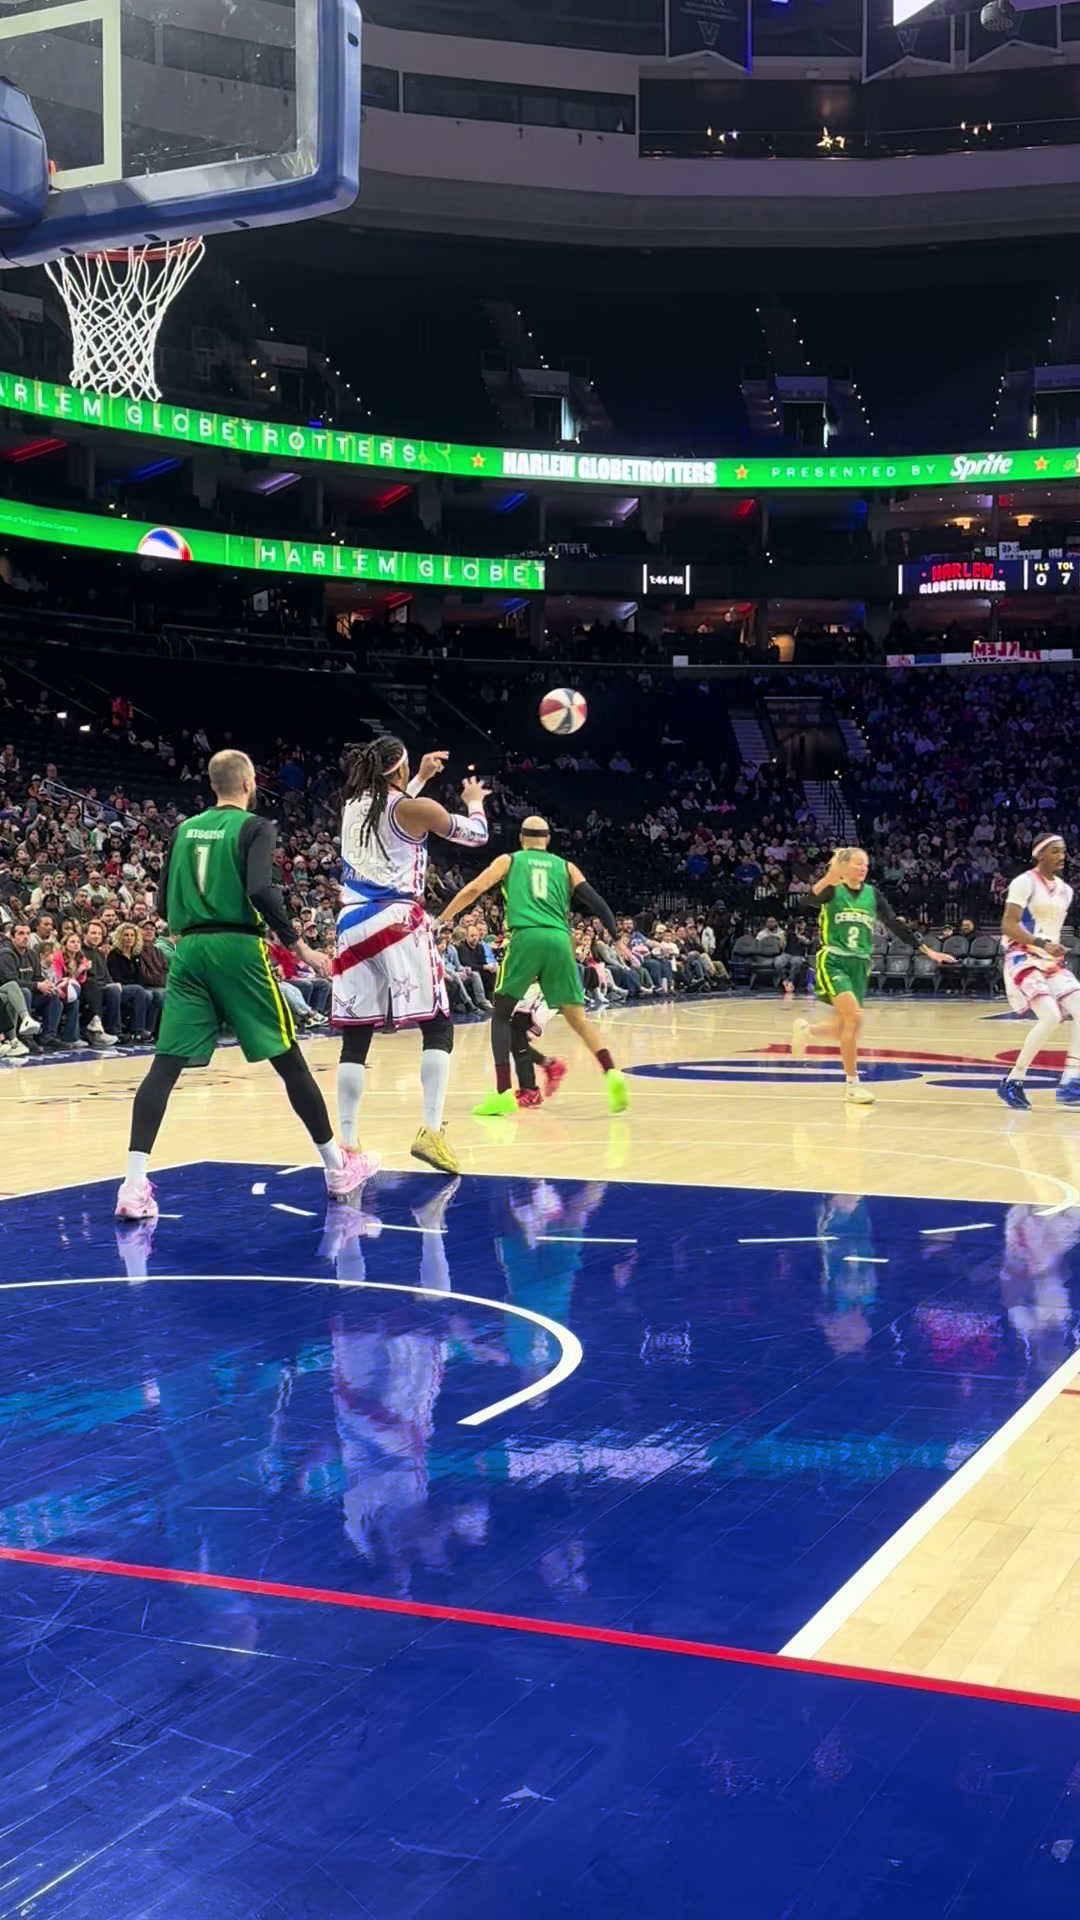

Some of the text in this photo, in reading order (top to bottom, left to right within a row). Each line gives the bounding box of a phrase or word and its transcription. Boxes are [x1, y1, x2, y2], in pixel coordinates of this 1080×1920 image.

[127, 405, 416, 463] GLOBETROTTERS
[503, 451, 717, 485] HARLEM GLOBETROTTERS
[771, 453, 1014, 480] PRESENTED BY Sprite
[261, 546, 545, 584] HARLEM GLOBET
[931, 561, 994, 581] HARLEM
[1034, 561, 1074, 571] FLS TOL
[649, 575, 684, 585] 1:46 PM
[919, 578, 1006, 594] GLOBETROTTERS
[1035, 572, 1071, 586] 0 7
[185, 828, 226, 840] HIGGINS
[196, 844, 211, 894] 1
[531, 868, 549, 900] 0
[847, 926, 860, 949] 2
